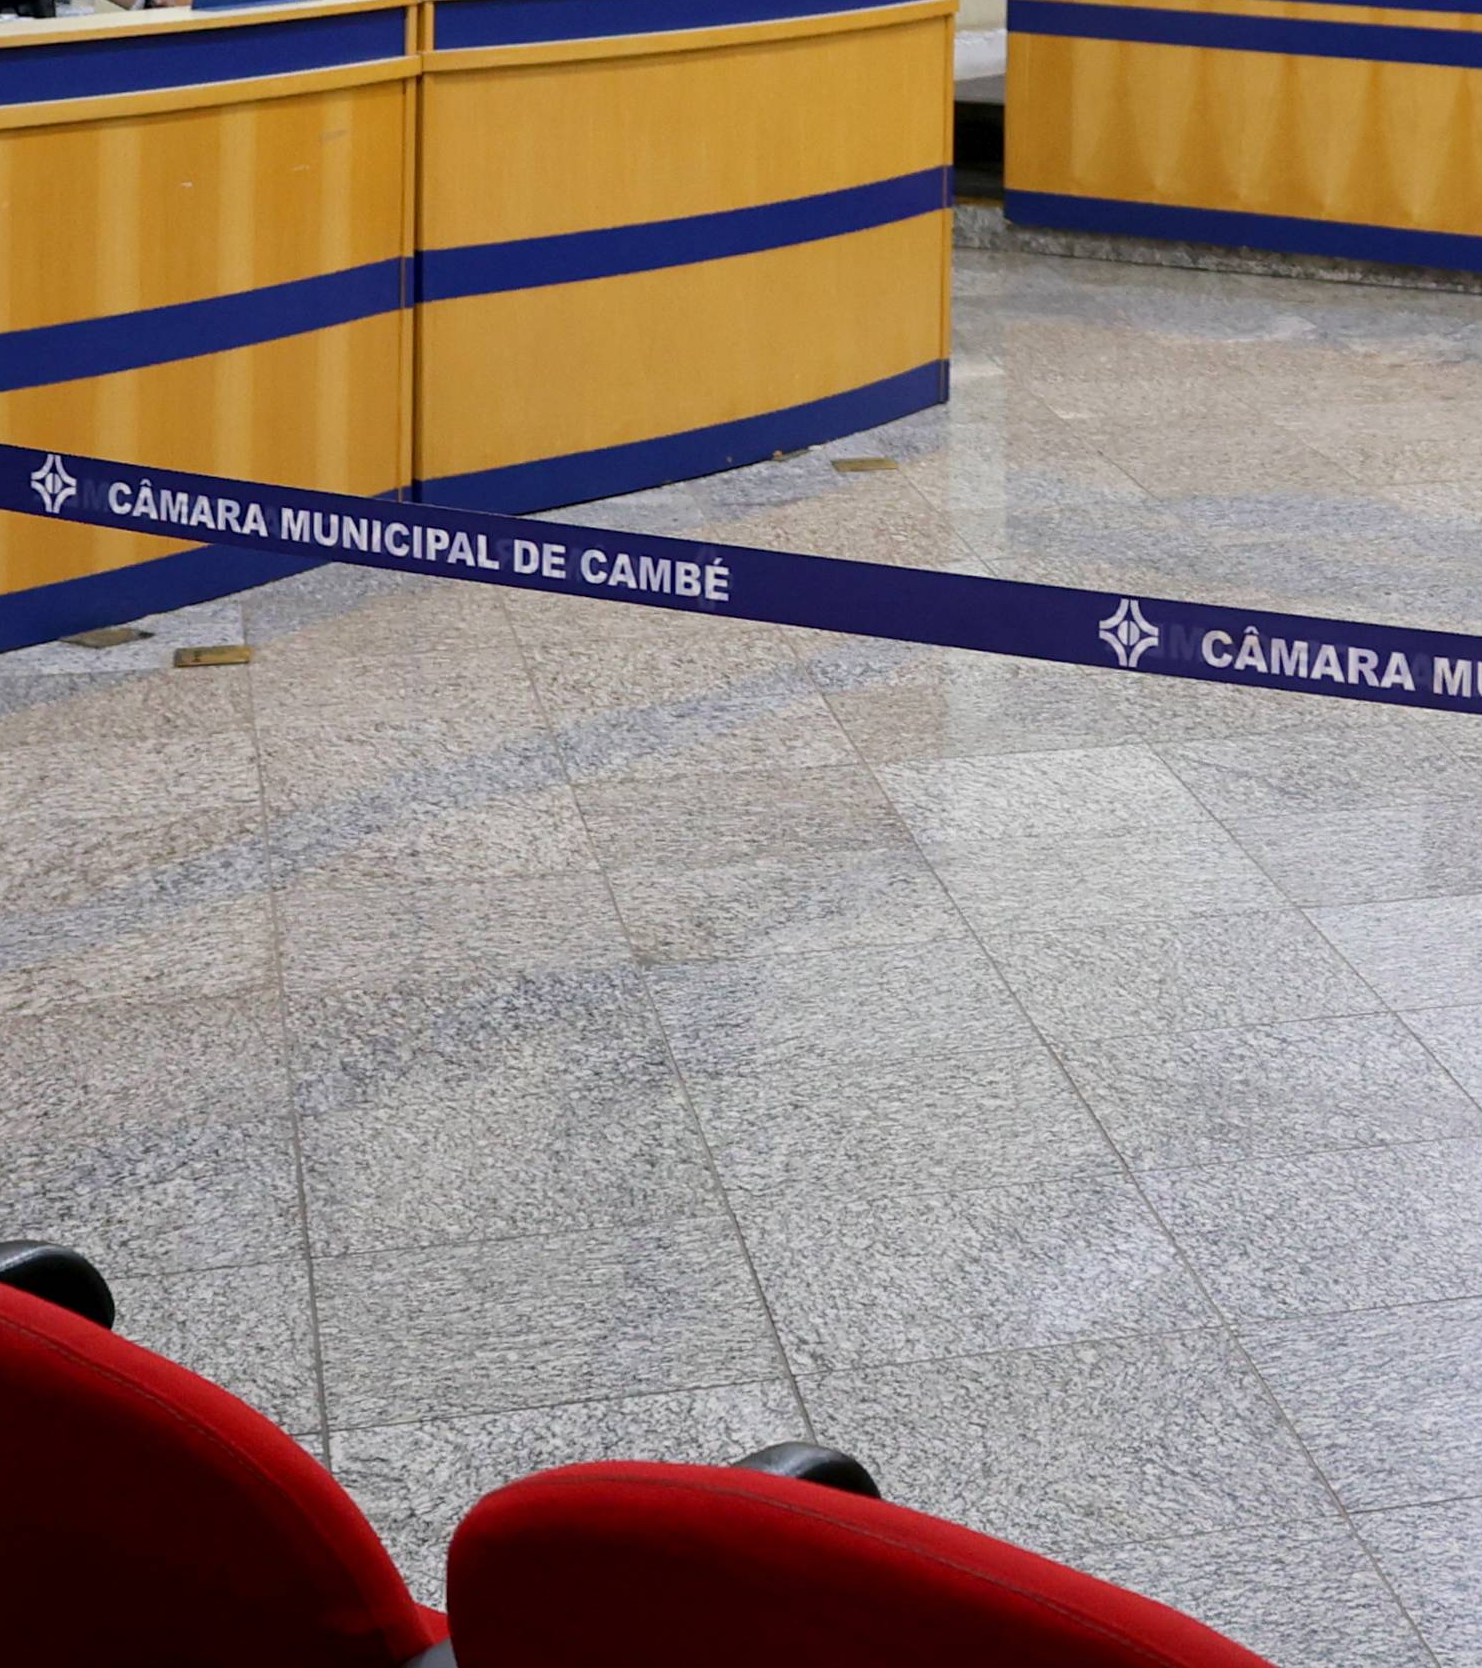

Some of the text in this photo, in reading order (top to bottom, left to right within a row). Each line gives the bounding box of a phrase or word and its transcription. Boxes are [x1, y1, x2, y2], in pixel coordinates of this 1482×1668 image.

[107, 478, 731, 602] CÂMARA MUNICIPAL DE CAMBÉ
[1200, 625, 1417, 692] CÂMARA
